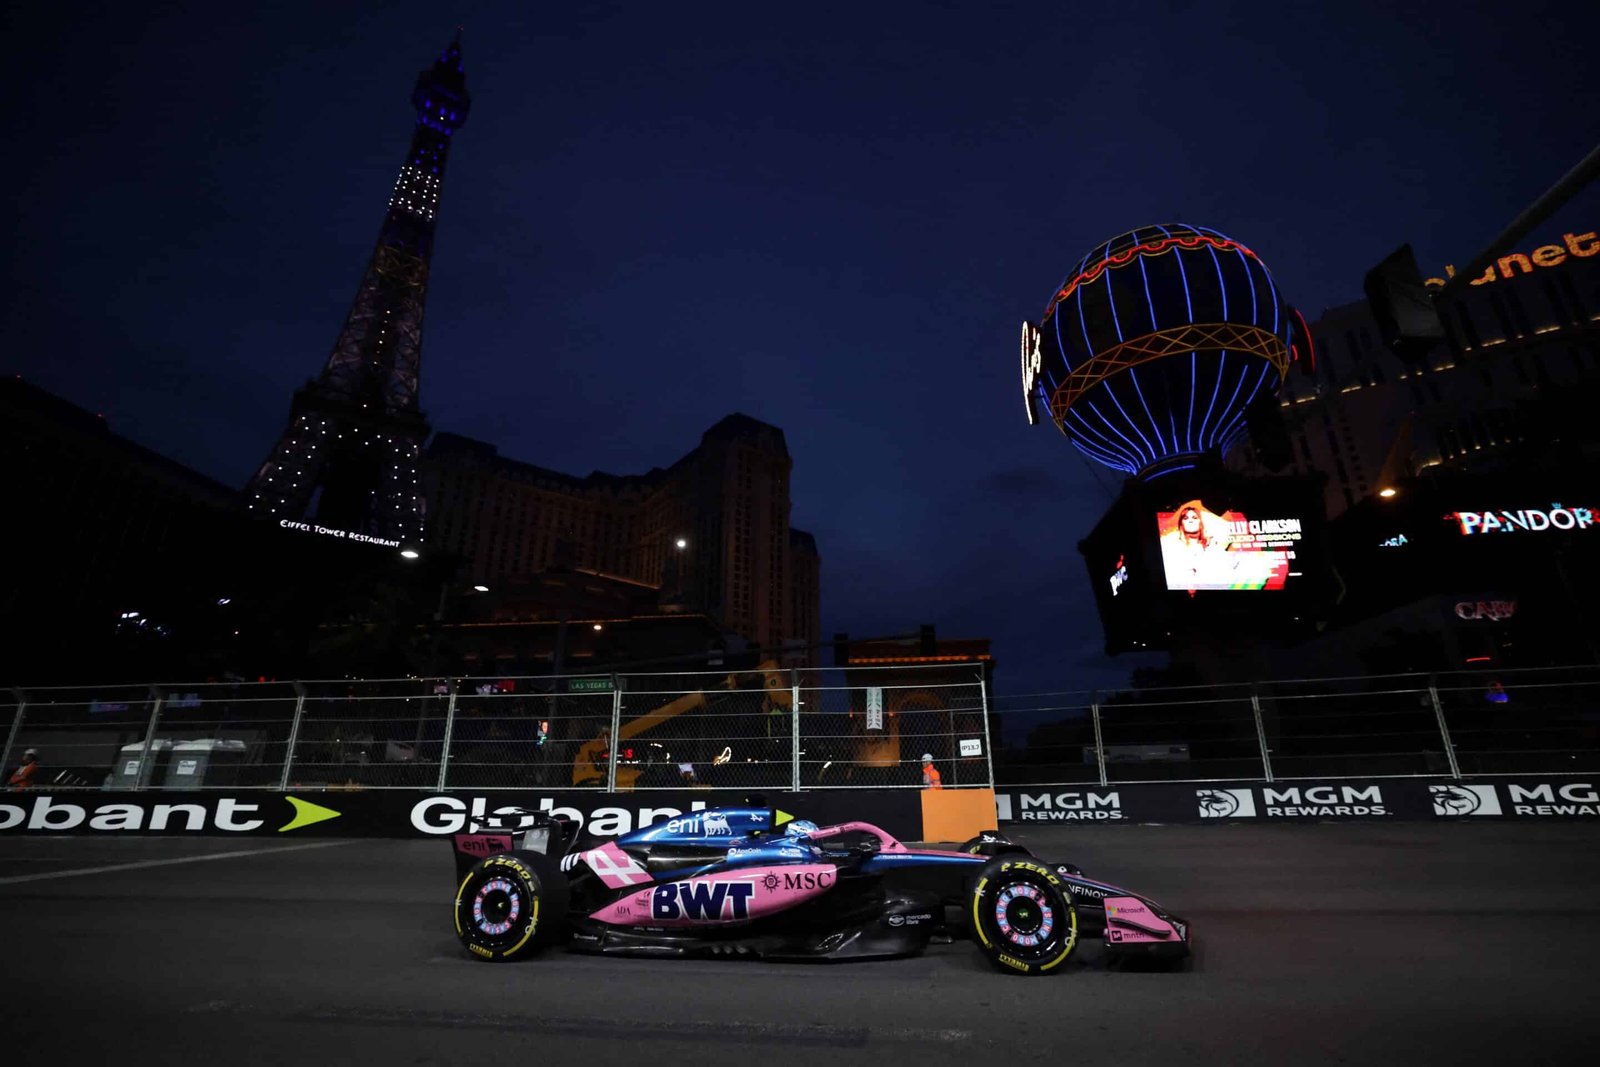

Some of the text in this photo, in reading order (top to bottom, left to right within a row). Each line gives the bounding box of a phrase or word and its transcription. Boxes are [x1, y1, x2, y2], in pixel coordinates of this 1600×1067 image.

[314, 525, 346, 538] TOWER
[349, 531, 401, 548] RESTAURANT
[571, 681, 585, 690] LAS
[586, 681, 607, 690] VEGAS
[1020, 791, 1121, 810] MGM
[1262, 785, 1383, 805] MGM
[1507, 783, 1600, 803] MG
[1021, 810, 1123, 820] REWARDS
[1266, 805, 1387, 817] REWARDS
[1514, 805, 1600, 816] REWA
[666, 813, 701, 834] eni
[462, 839, 485, 851] eni
[784, 872, 832, 890] MSC
[1013, 861, 1060, 885] ZERO
[652, 881, 754, 921] BWT
